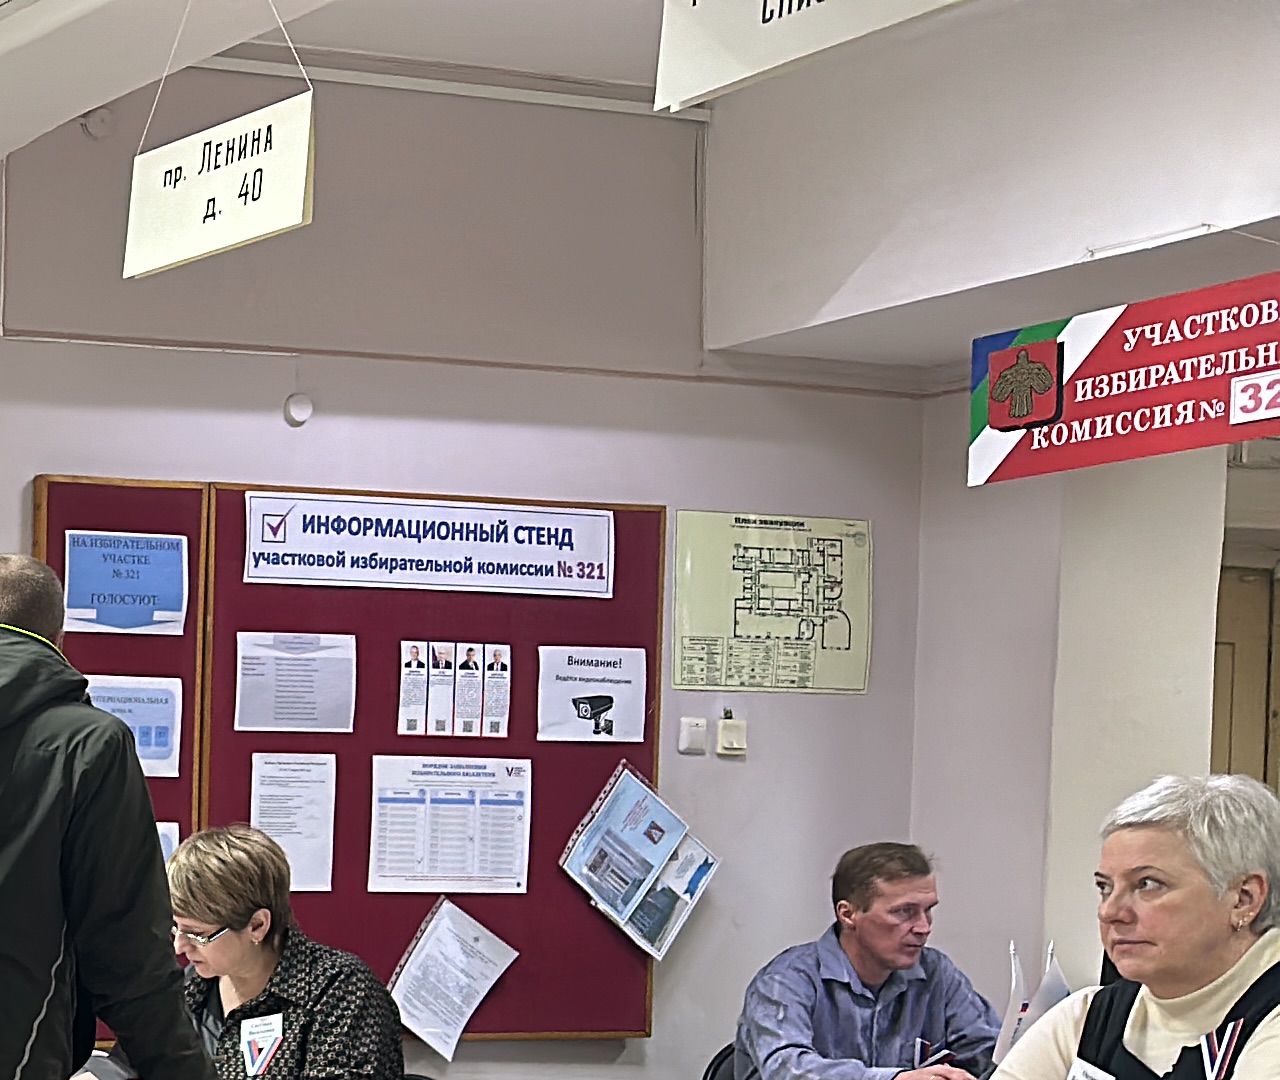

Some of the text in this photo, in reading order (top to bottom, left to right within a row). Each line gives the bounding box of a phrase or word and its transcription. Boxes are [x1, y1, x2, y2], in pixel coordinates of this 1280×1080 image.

[163, 124, 273, 189] пр. ЛЕНИНА
[202, 167, 263, 224] д. 40
[1122, 299, 1280, 352] УЧАСТКОВ
[1074, 341, 1280, 404] ИЗБИРАТЕЛЬН
[1029, 399, 1196, 451] КОМИССИЯ
[1198, 398, 1225, 423] №
[72, 537, 180, 552] НА ИЗБИРАТЕЛЬНОМ
[301, 513, 575, 551] ИНФОРМАЦИОННЫЙ СТЕНД
[101, 553, 151, 565] УЧАСТКЕ
[112, 568, 140, 580] № 321
[252, 550, 606, 580] участковой избирательной комиссии № 321
[567, 655, 623, 669] Внимание!
[92, 695, 169, 705] НТЕРНАЦИОНАЛЬНАЯ
